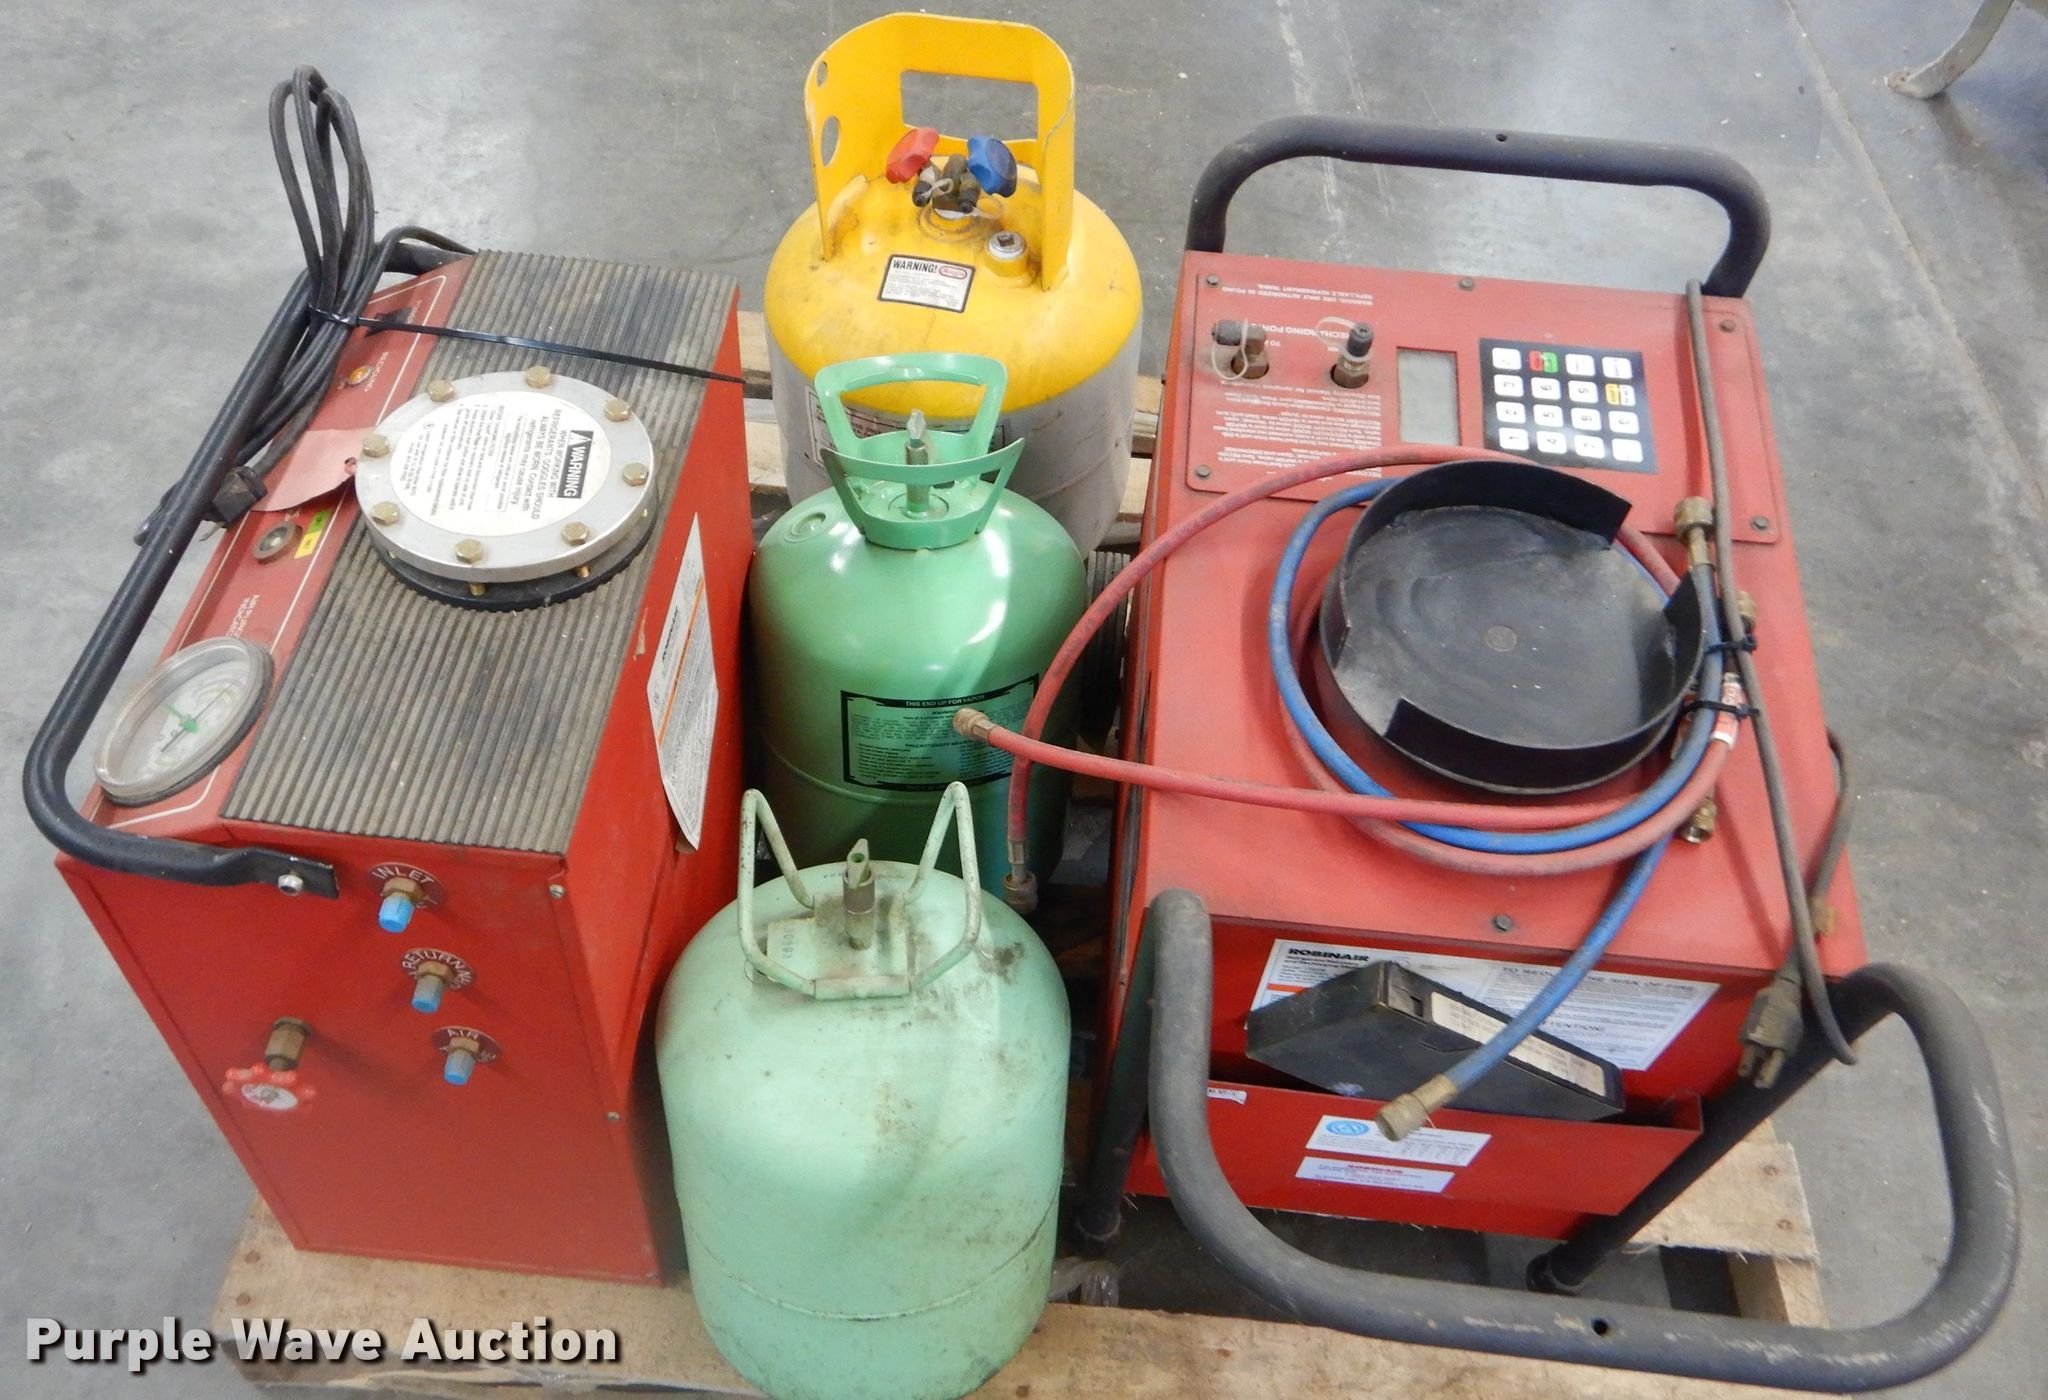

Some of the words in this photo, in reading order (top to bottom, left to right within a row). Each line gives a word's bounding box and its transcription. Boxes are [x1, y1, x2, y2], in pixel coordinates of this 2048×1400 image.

[893, 260, 938, 273] WARNING!
[521, 420, 536, 452] refrigerants
[536, 416, 548, 439] ALWAYS
[557, 430, 567, 447] WHEN
[519, 454, 528, 465] may
[550, 449, 563, 479] WORKING
[515, 468, 525, 485] cause
[537, 459, 550, 490] GOGGLES
[562, 446, 586, 496] WARNING
[524, 472, 536, 496] Contact
[547, 481, 556, 497] WITH
[521, 498, 531, 510] with
[530, 492, 543, 519] SHOULD
[371, 865, 435, 883] INLET
[402, 950, 466, 970] RETURN
[1288, 948, 1369, 961] ROBINAIR
[447, 1029, 479, 1040] AIR
